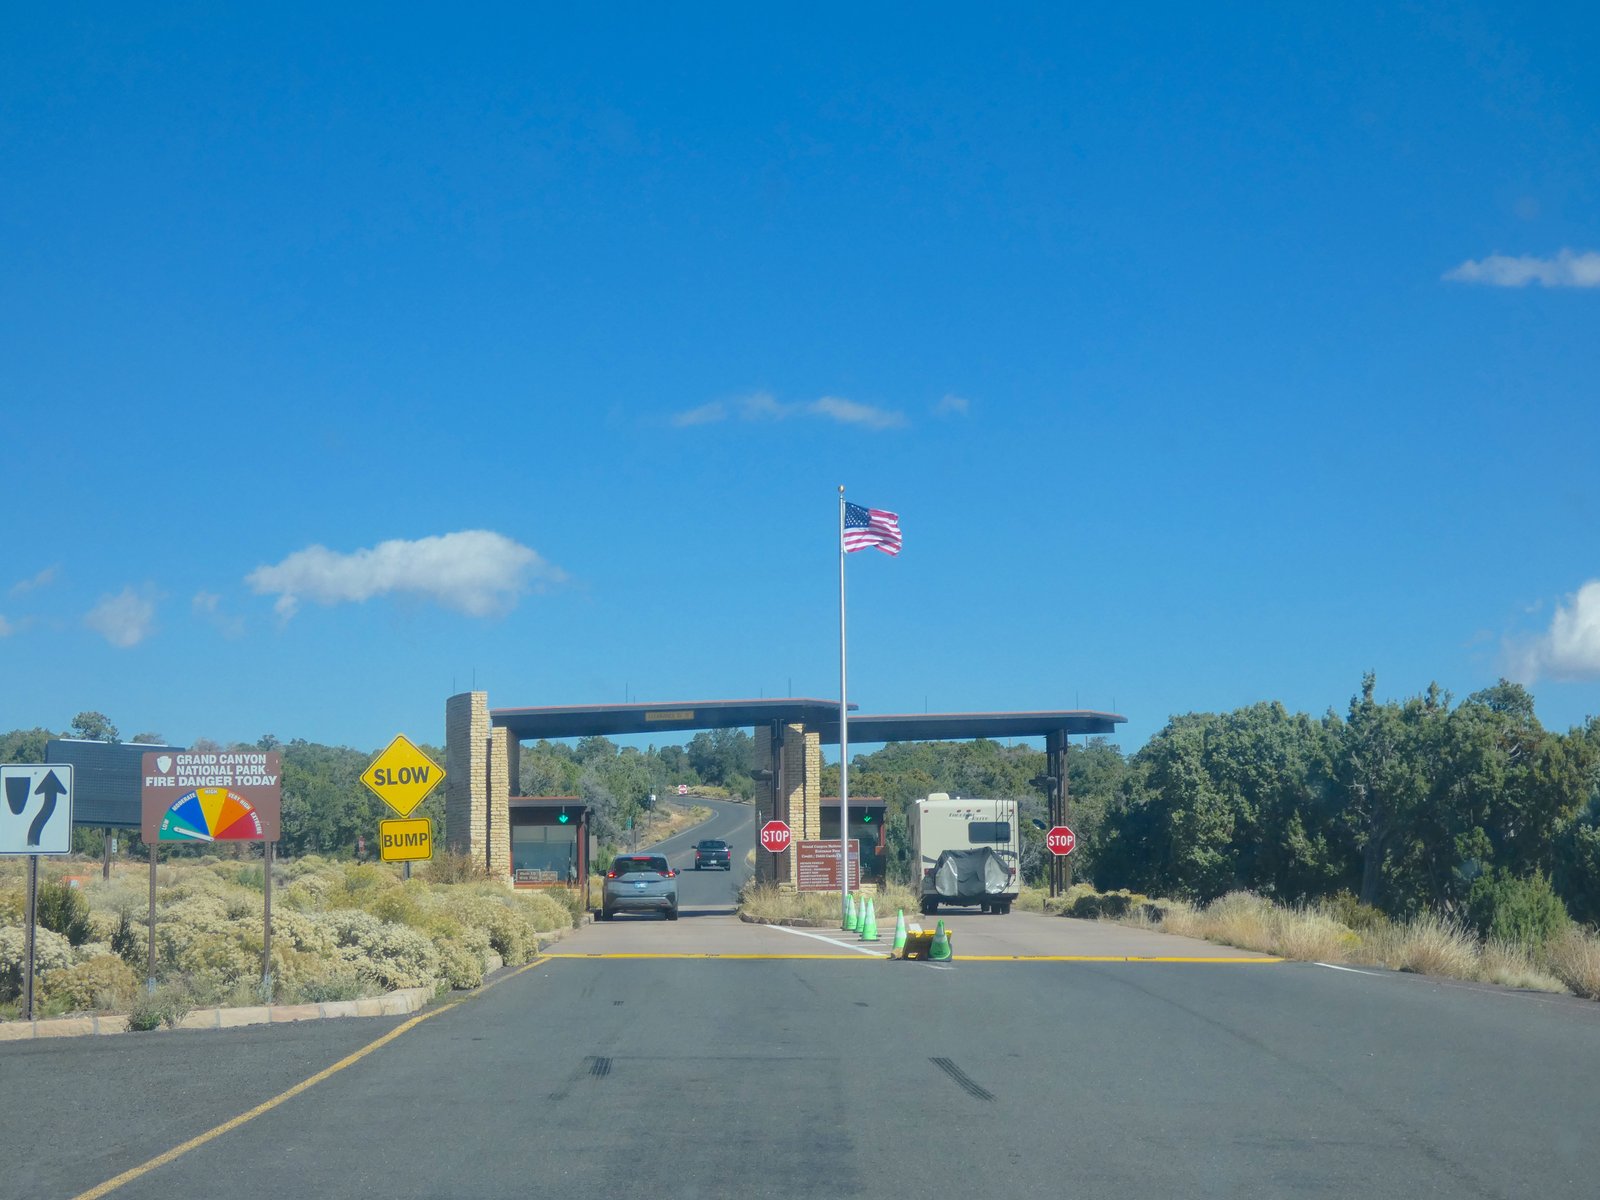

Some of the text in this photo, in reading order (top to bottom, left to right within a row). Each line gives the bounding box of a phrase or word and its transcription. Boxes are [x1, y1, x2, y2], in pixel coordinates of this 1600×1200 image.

[176, 754, 267, 765] GRAND CANYON
[176, 765, 266, 776] NATIONAL PARK
[374, 766, 430, 787] SLOW
[145, 775, 278, 787] FIRE DANGER TODAY
[171, 793, 197, 811] MODERATE
[228, 793, 251, 810] VERY HIGH
[161, 818, 169, 830] LOW
[250, 811, 262, 834] EXTREME
[383, 832, 428, 848] BUMP
[763, 830, 790, 843] STOP
[1048, 835, 1074, 847] STOP
